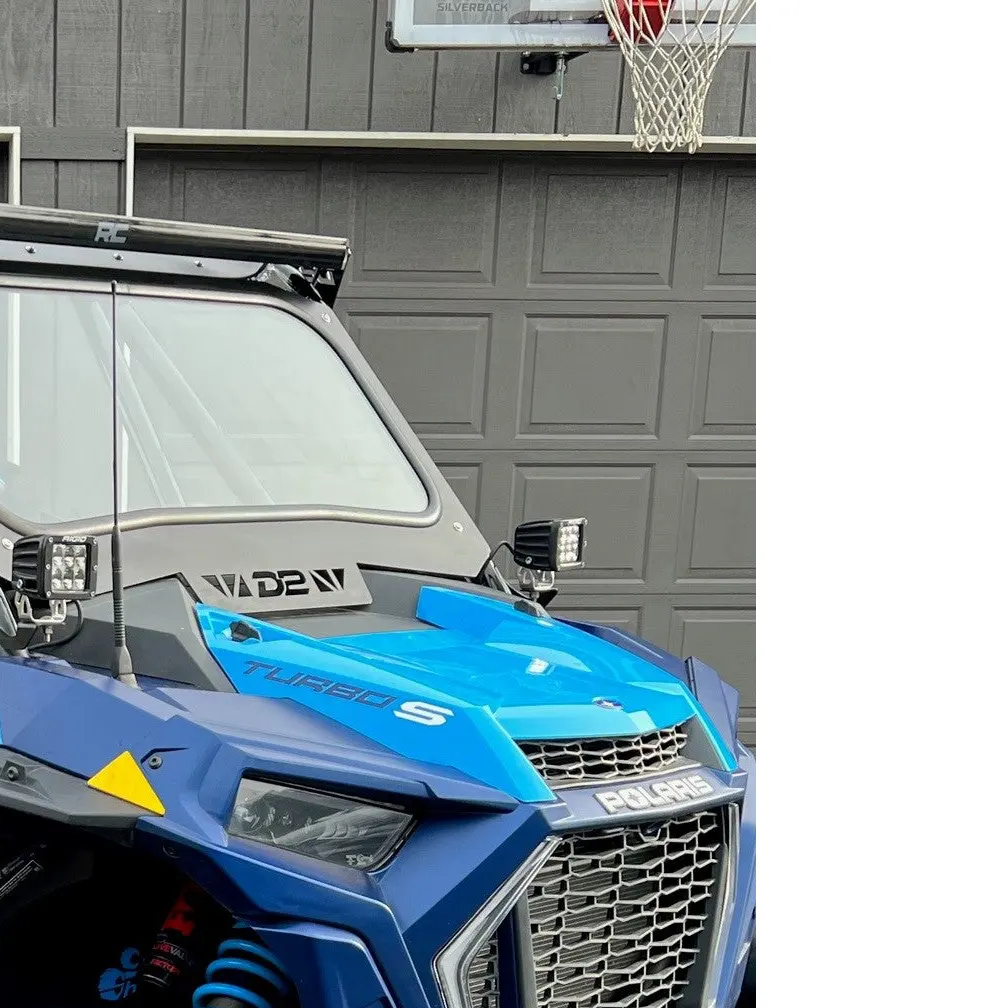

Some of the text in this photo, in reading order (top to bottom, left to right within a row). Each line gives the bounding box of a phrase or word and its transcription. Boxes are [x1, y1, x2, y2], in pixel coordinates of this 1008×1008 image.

[437, 3, 508, 12] SILVERBACK
[94, 221, 130, 244] RC
[252, 569, 310, 598] D2
[243, 660, 455, 726] TURBO S
[593, 775, 714, 815] POLARIS
